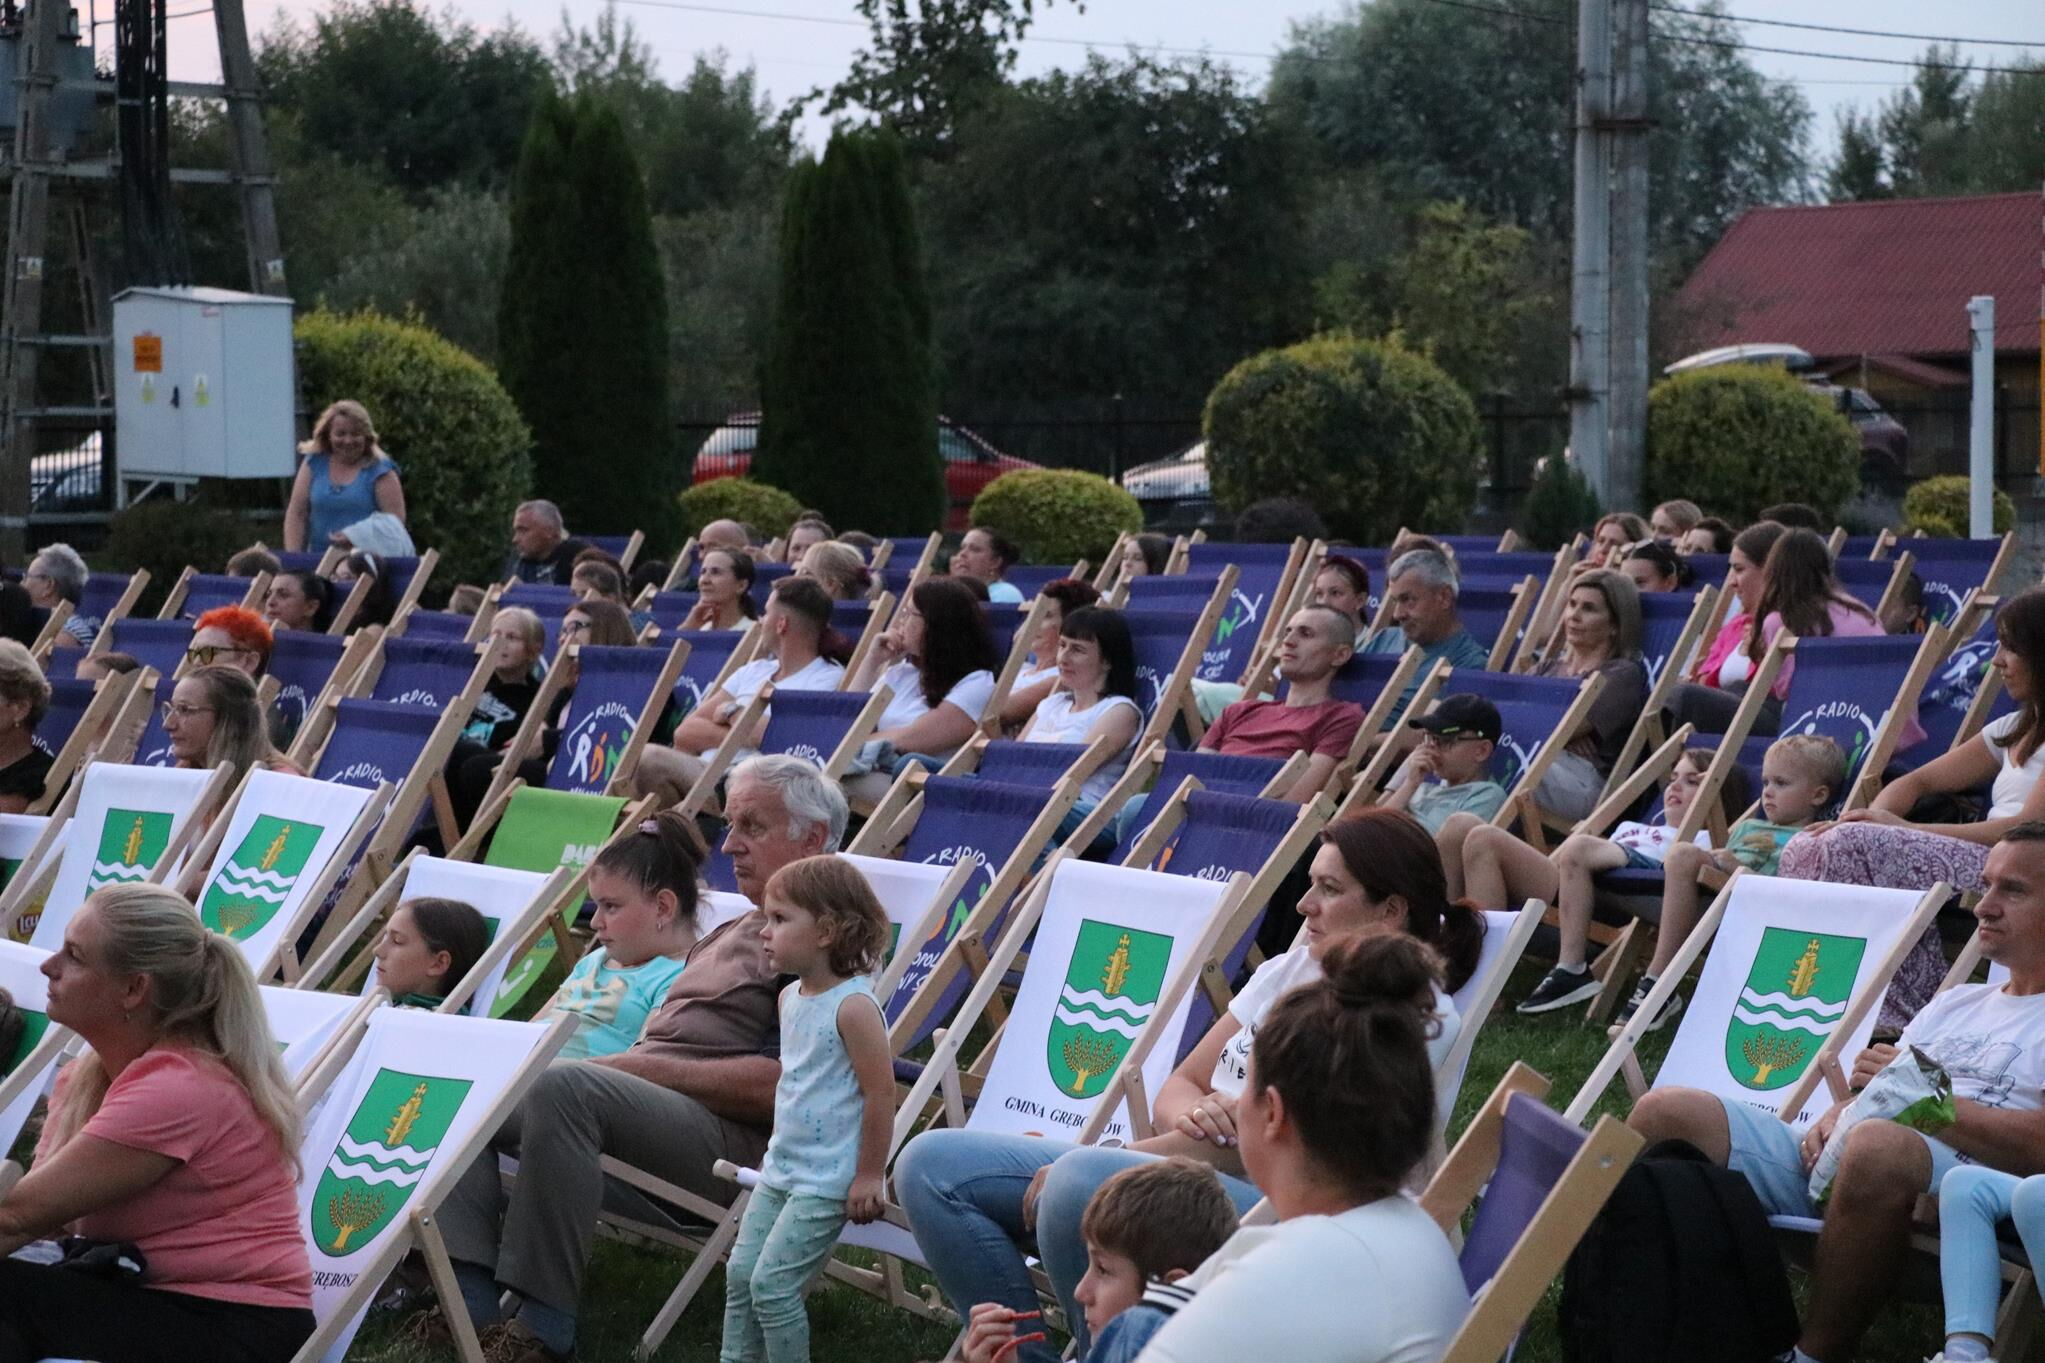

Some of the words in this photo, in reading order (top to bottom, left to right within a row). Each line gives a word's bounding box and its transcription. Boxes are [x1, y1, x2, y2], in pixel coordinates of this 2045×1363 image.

[595, 702, 627, 719] RADIO
[1816, 701, 1860, 720] RADIO
[344, 763, 382, 782] RADIO
[1197, 864, 1232, 883] RADI
[1004, 1096, 1046, 1119] GMINA
